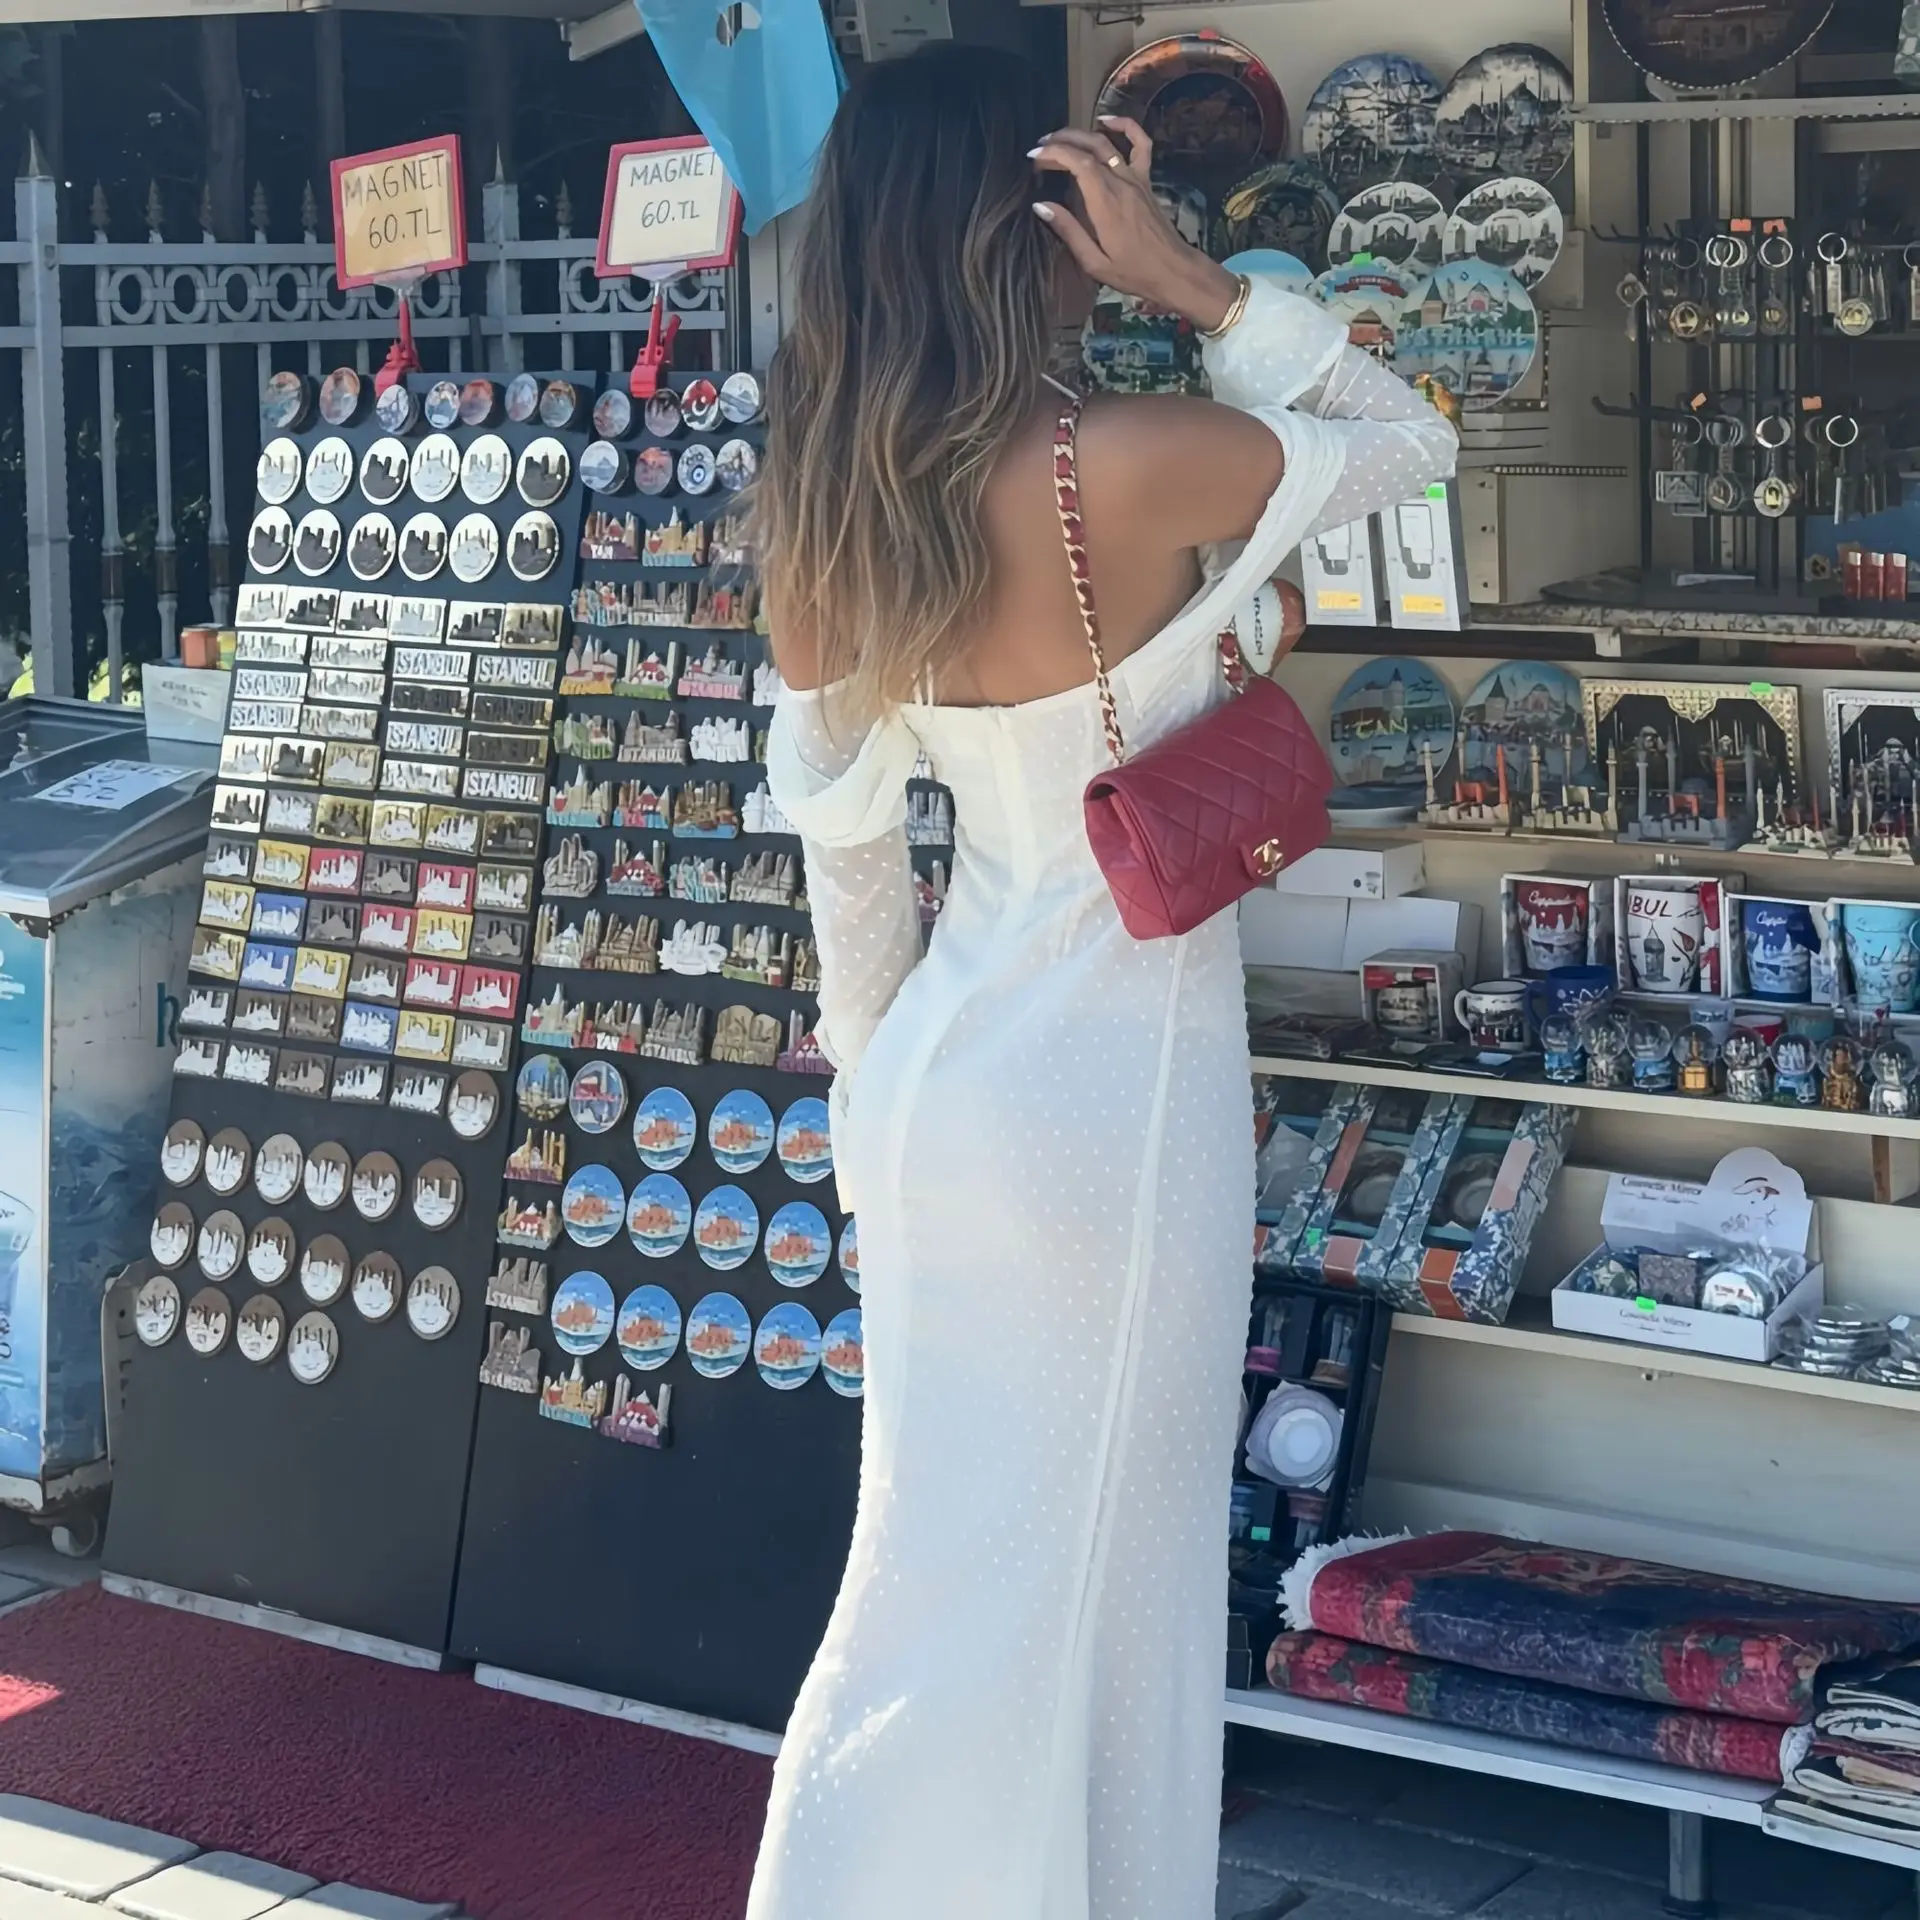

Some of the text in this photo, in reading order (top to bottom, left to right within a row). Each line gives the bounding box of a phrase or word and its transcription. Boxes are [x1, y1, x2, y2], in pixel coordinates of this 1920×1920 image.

[344, 154, 445, 208] MAGNET
[630, 151, 717, 187] MAGNET
[368, 207, 442, 249] 60.TL
[640, 199, 700, 228] 60.TL
